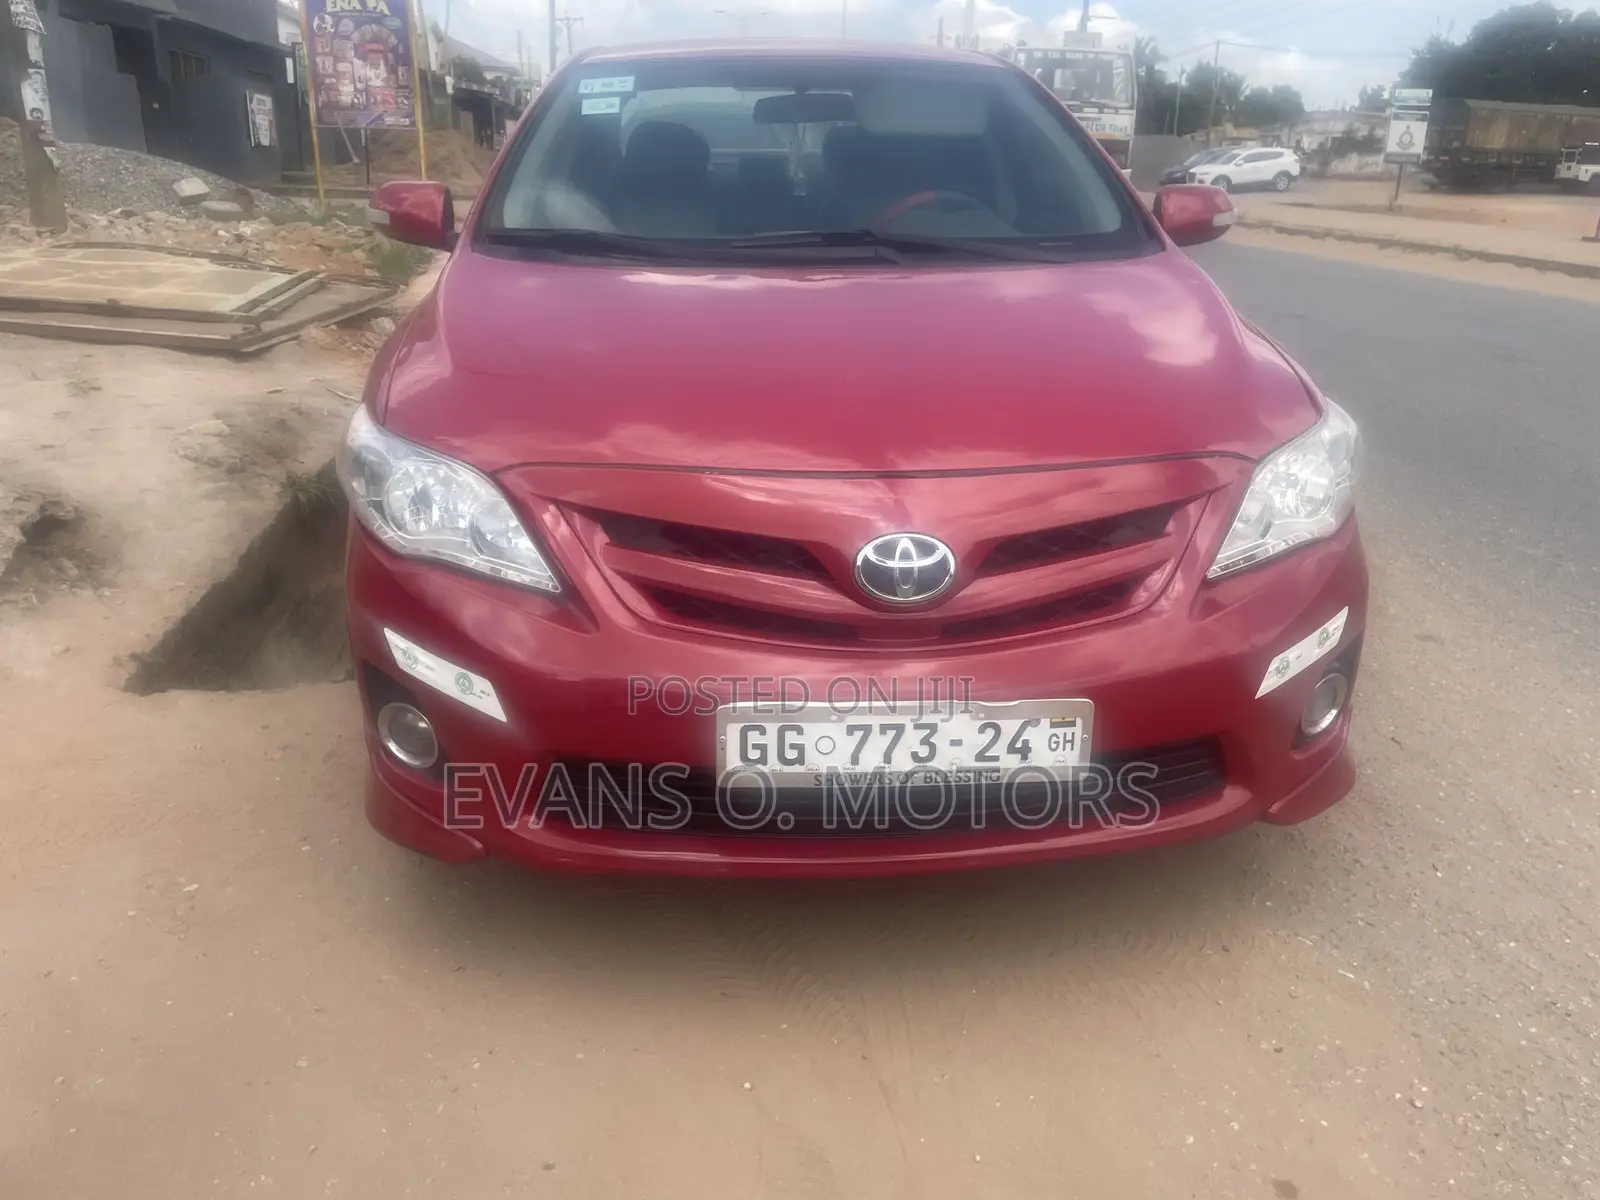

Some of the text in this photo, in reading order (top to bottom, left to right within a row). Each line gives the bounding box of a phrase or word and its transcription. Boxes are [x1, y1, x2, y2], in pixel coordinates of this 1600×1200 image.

[739, 724, 806, 766] GG
[1047, 732, 1076, 752] GH
[924, 769, 1000, 785] BLESSING
